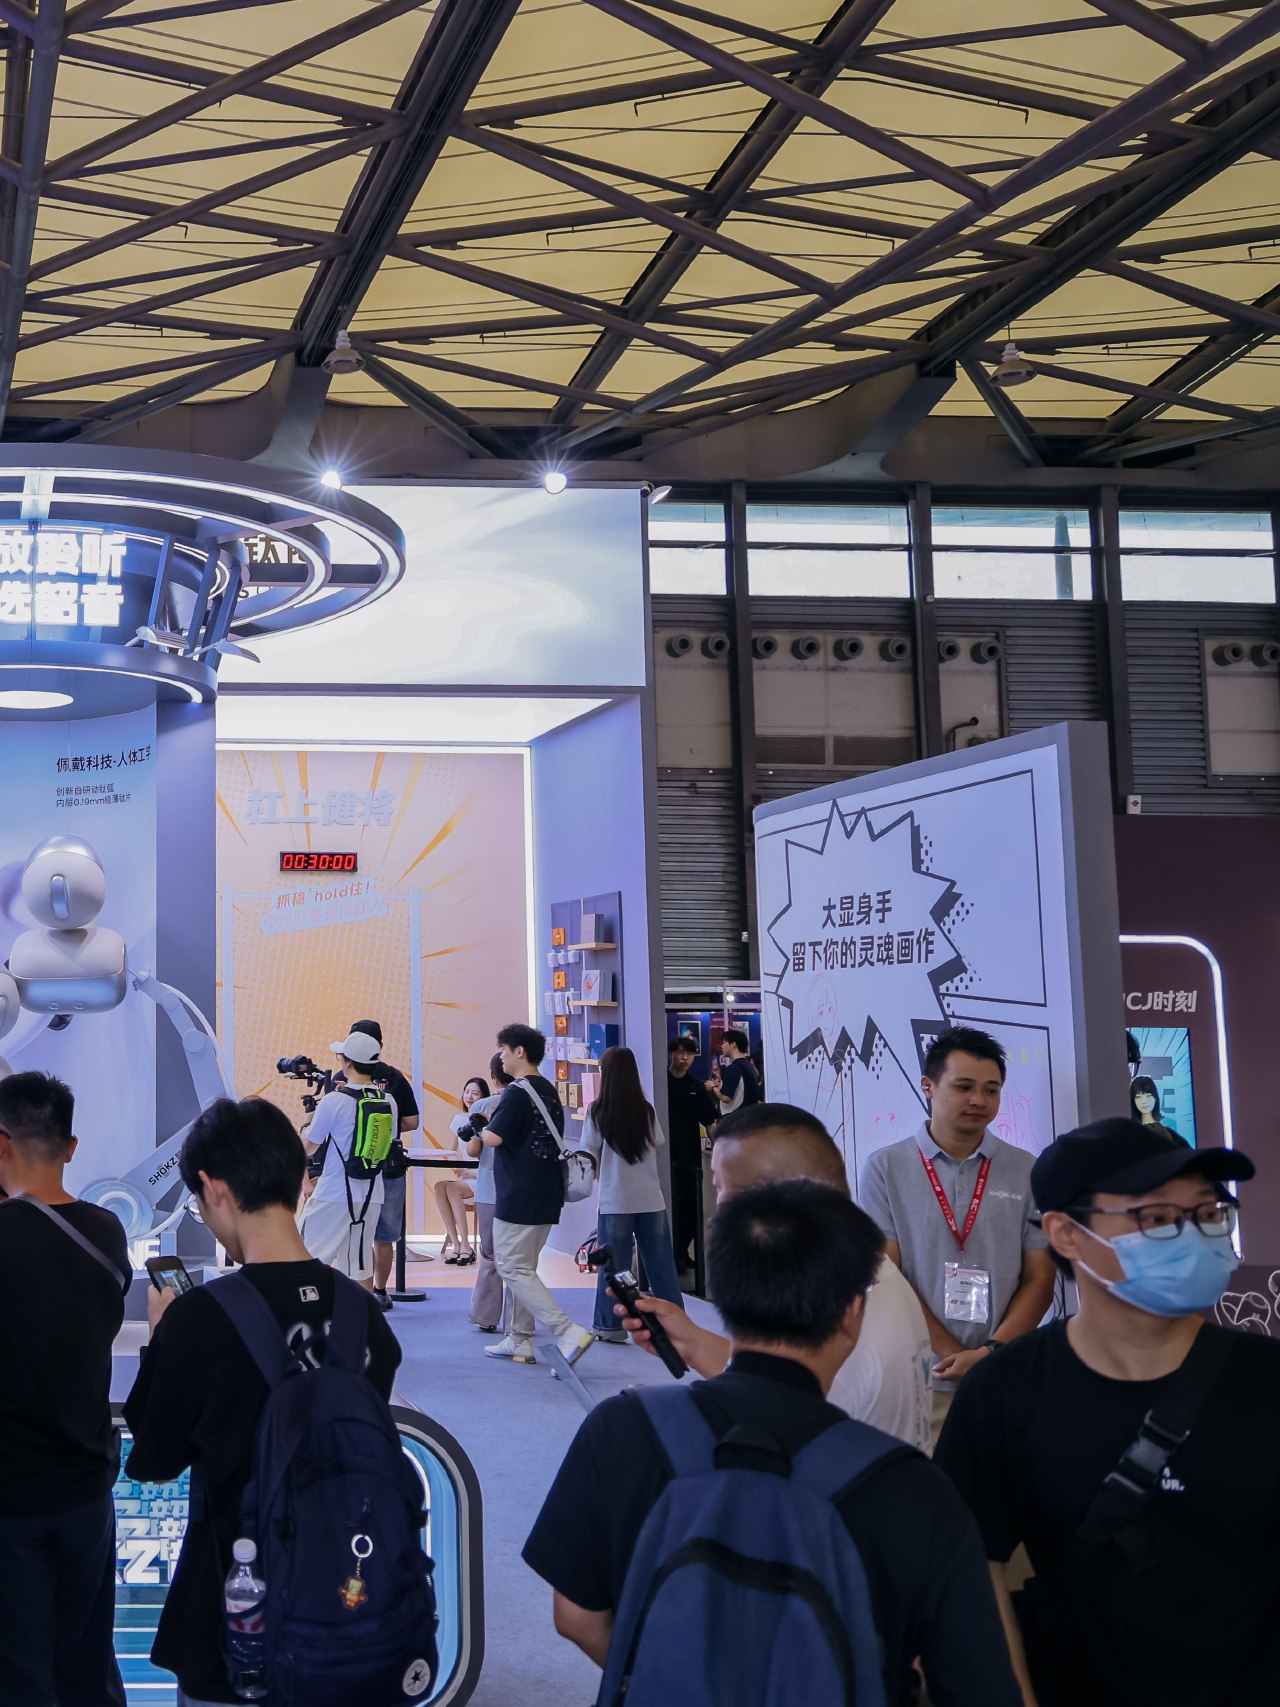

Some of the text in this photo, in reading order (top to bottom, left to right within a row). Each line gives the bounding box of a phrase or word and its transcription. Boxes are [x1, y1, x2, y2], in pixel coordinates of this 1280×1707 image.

[244, 788, 397, 828] 杠上健将
[282, 853, 355, 871] 00:30:00
[276, 892, 306, 910] 抓稳
[821, 889, 893, 931] 大显身手
[792, 926, 937, 973] 留下你的灵魂画作
[1122, 989, 1198, 1013] CJ时刻
[148, 1156, 178, 1186] SHOKZ
